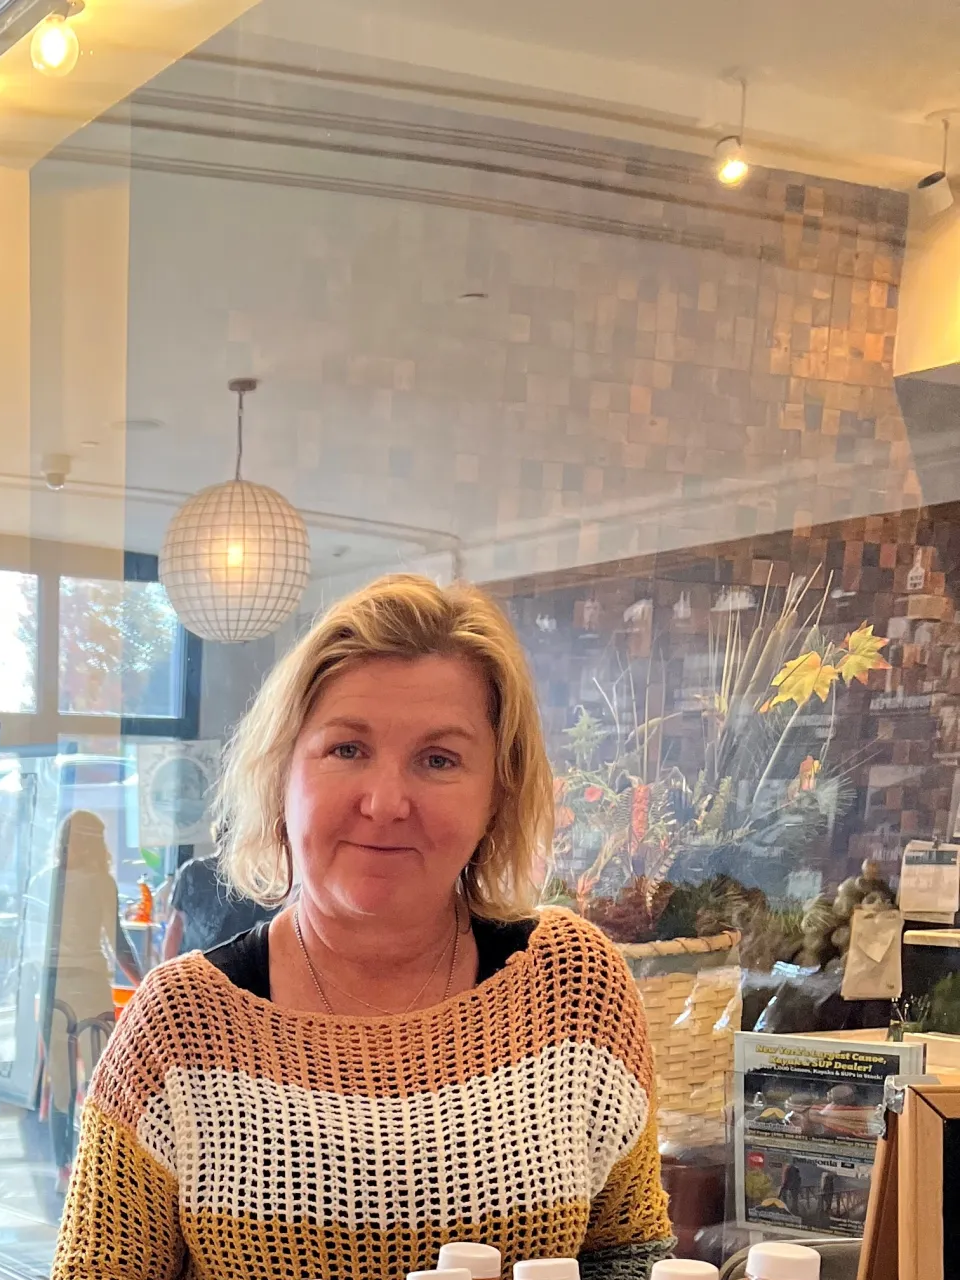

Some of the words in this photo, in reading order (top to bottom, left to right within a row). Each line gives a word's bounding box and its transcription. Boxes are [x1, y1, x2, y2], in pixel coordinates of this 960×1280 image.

[755, 1044, 778, 1053] New
[812, 1048, 851, 1060] Largest
[852, 1053, 887, 1064] Canoe,
[812, 1059, 832, 1068] SUP
[834, 1062, 873, 1073] Dealer!
